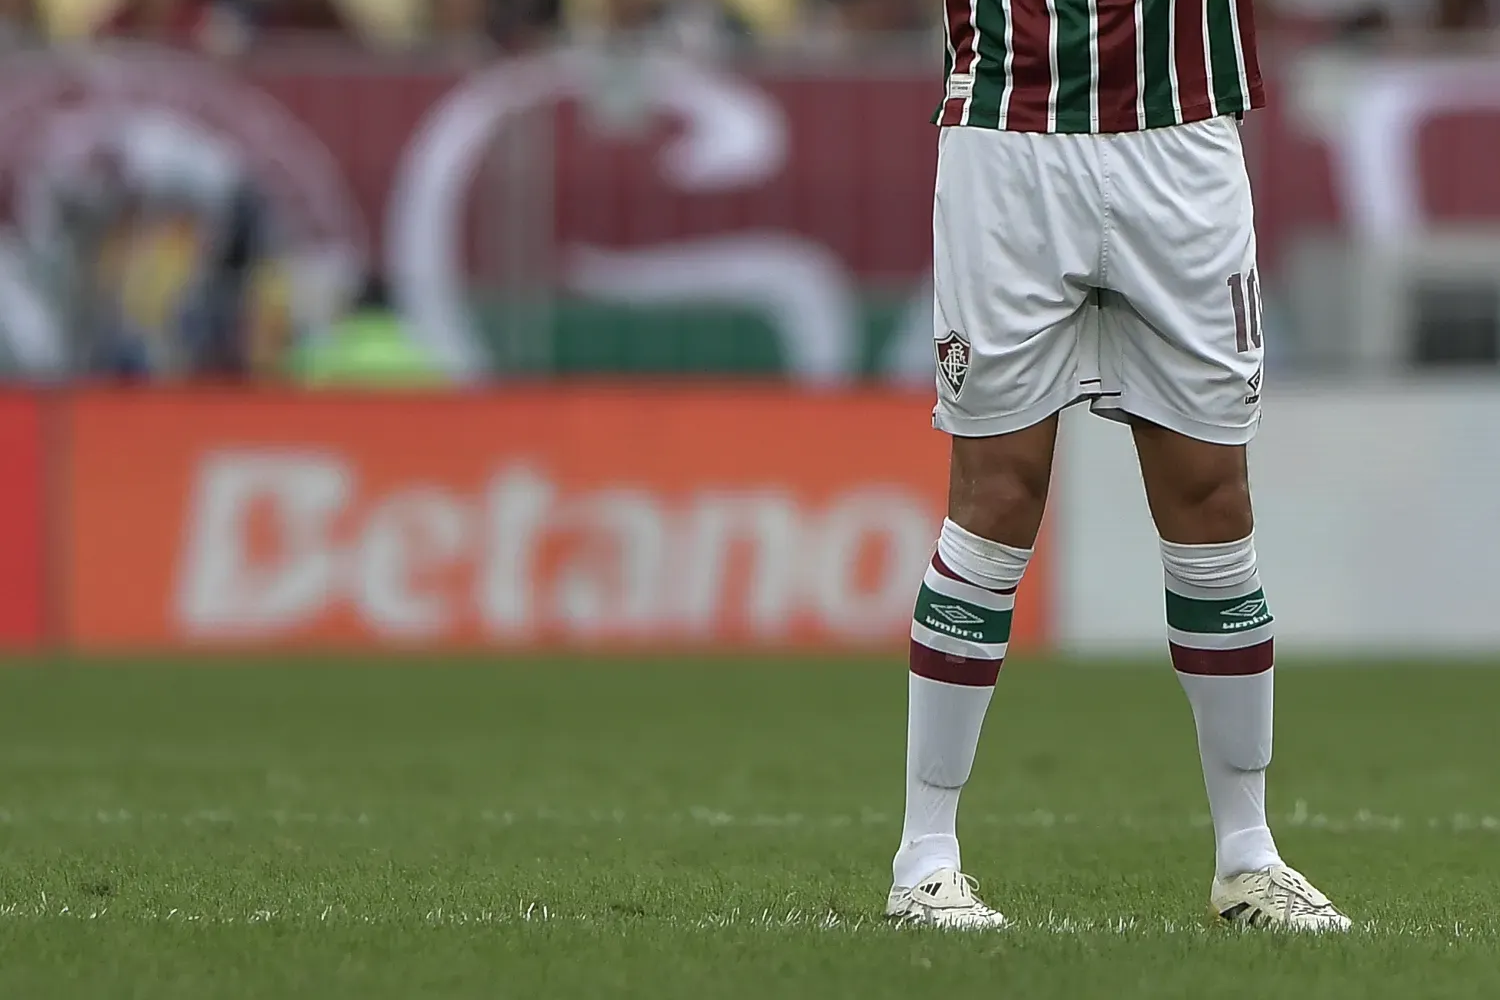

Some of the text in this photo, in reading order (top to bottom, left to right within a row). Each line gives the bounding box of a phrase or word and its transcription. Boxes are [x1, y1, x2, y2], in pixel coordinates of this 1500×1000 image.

[176, 452, 938, 638] Betano
[925, 615, 983, 639] umbro
[1222, 614, 1269, 629] umbr
